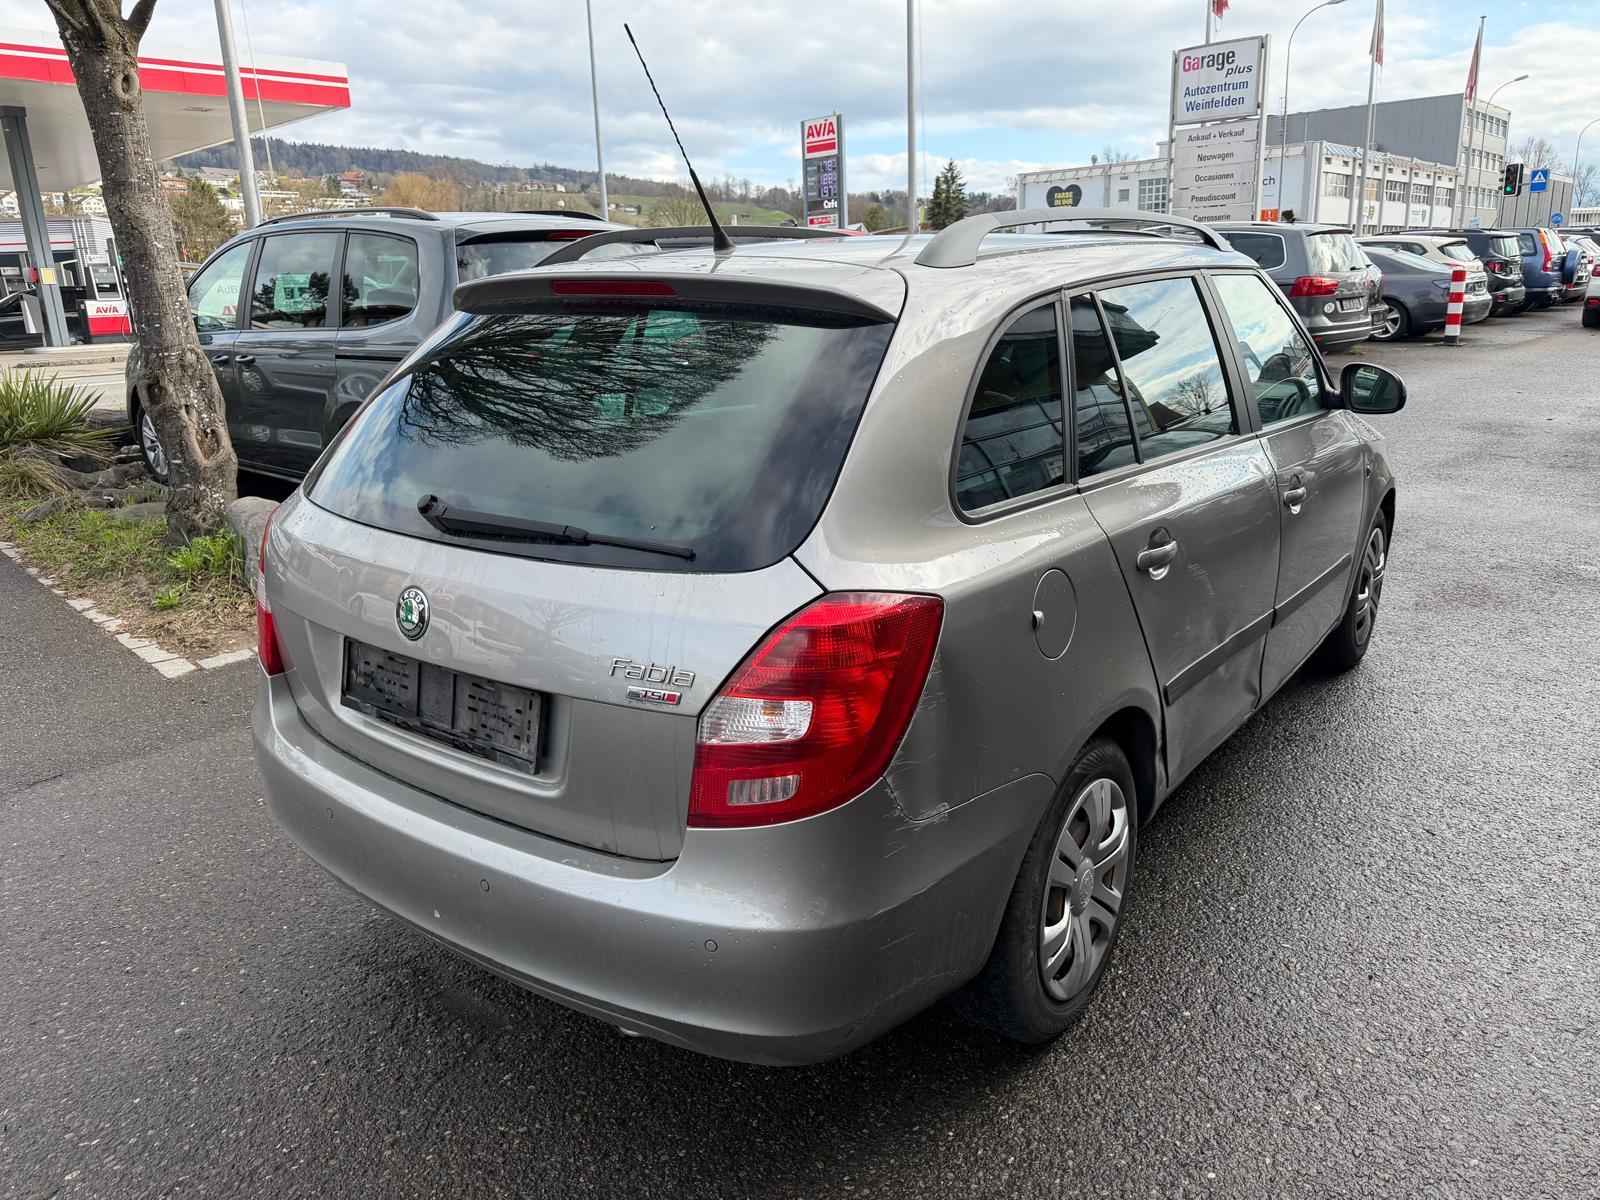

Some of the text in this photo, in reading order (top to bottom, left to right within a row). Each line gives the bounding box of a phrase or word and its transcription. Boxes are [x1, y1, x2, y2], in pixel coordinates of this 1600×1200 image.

[1183, 50, 1236, 73] Garage
[1225, 64, 1253, 79] plus
[1183, 80, 1249, 98] Autozentrum
[1185, 95, 1245, 112] Weinfelden
[1187, 132, 1211, 143] Ankauf
[1218, 127, 1245, 139] Verkauf
[1197, 151, 1234, 162] Neuwagen
[1194, 172, 1234, 182] Occasionen
[1190, 192, 1236, 202] Pneudiscount
[1192, 213, 1231, 222] Carrosserie
[609, 657, 696, 688] Fabia
[641, 689, 666, 701] TSI
